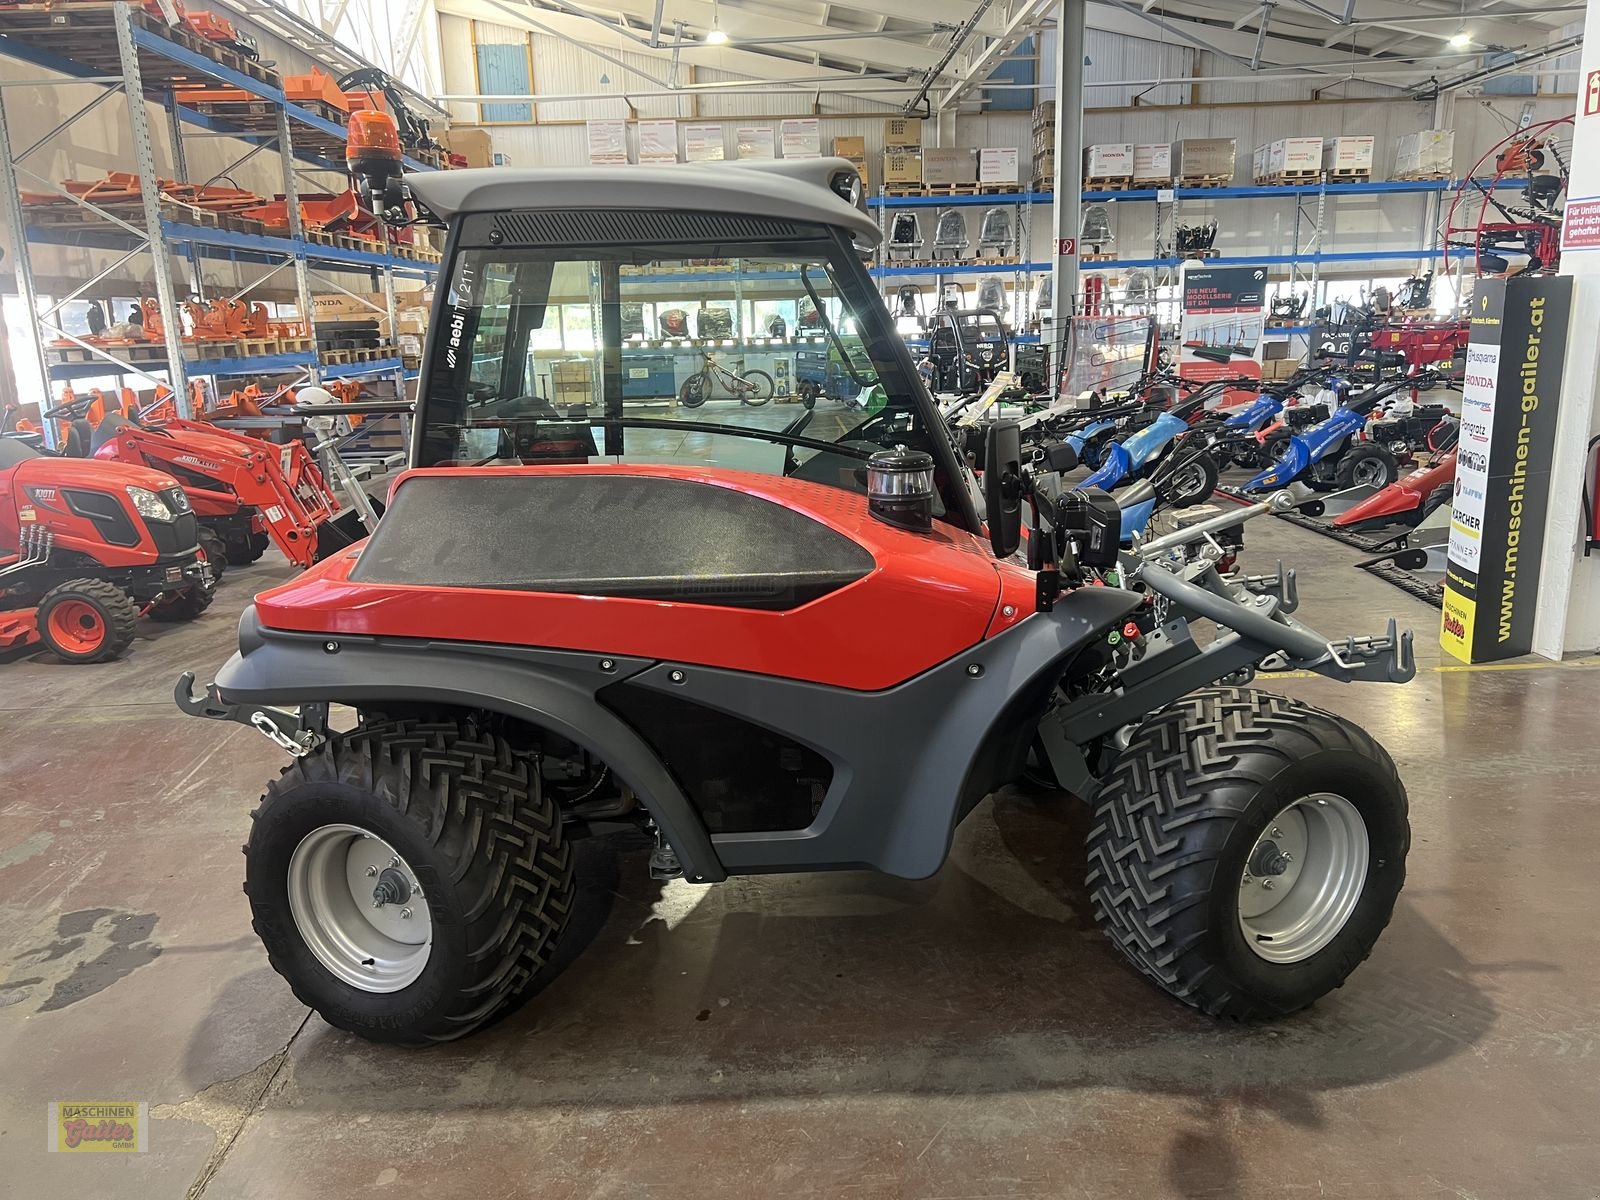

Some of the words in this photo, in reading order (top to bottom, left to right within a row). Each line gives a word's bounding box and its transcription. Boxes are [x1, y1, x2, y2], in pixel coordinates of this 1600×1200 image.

[1568, 207, 1580, 216] Für
[1568, 217, 1585, 226] wird
[1568, 226, 1599, 239] gehaftet
[312, 299, 343, 307] ONDA
[450, 315, 465, 347] aebi
[1465, 375, 1494, 389] HONDA
[1498, 297, 1546, 643] www.maschinen-gailer.at
